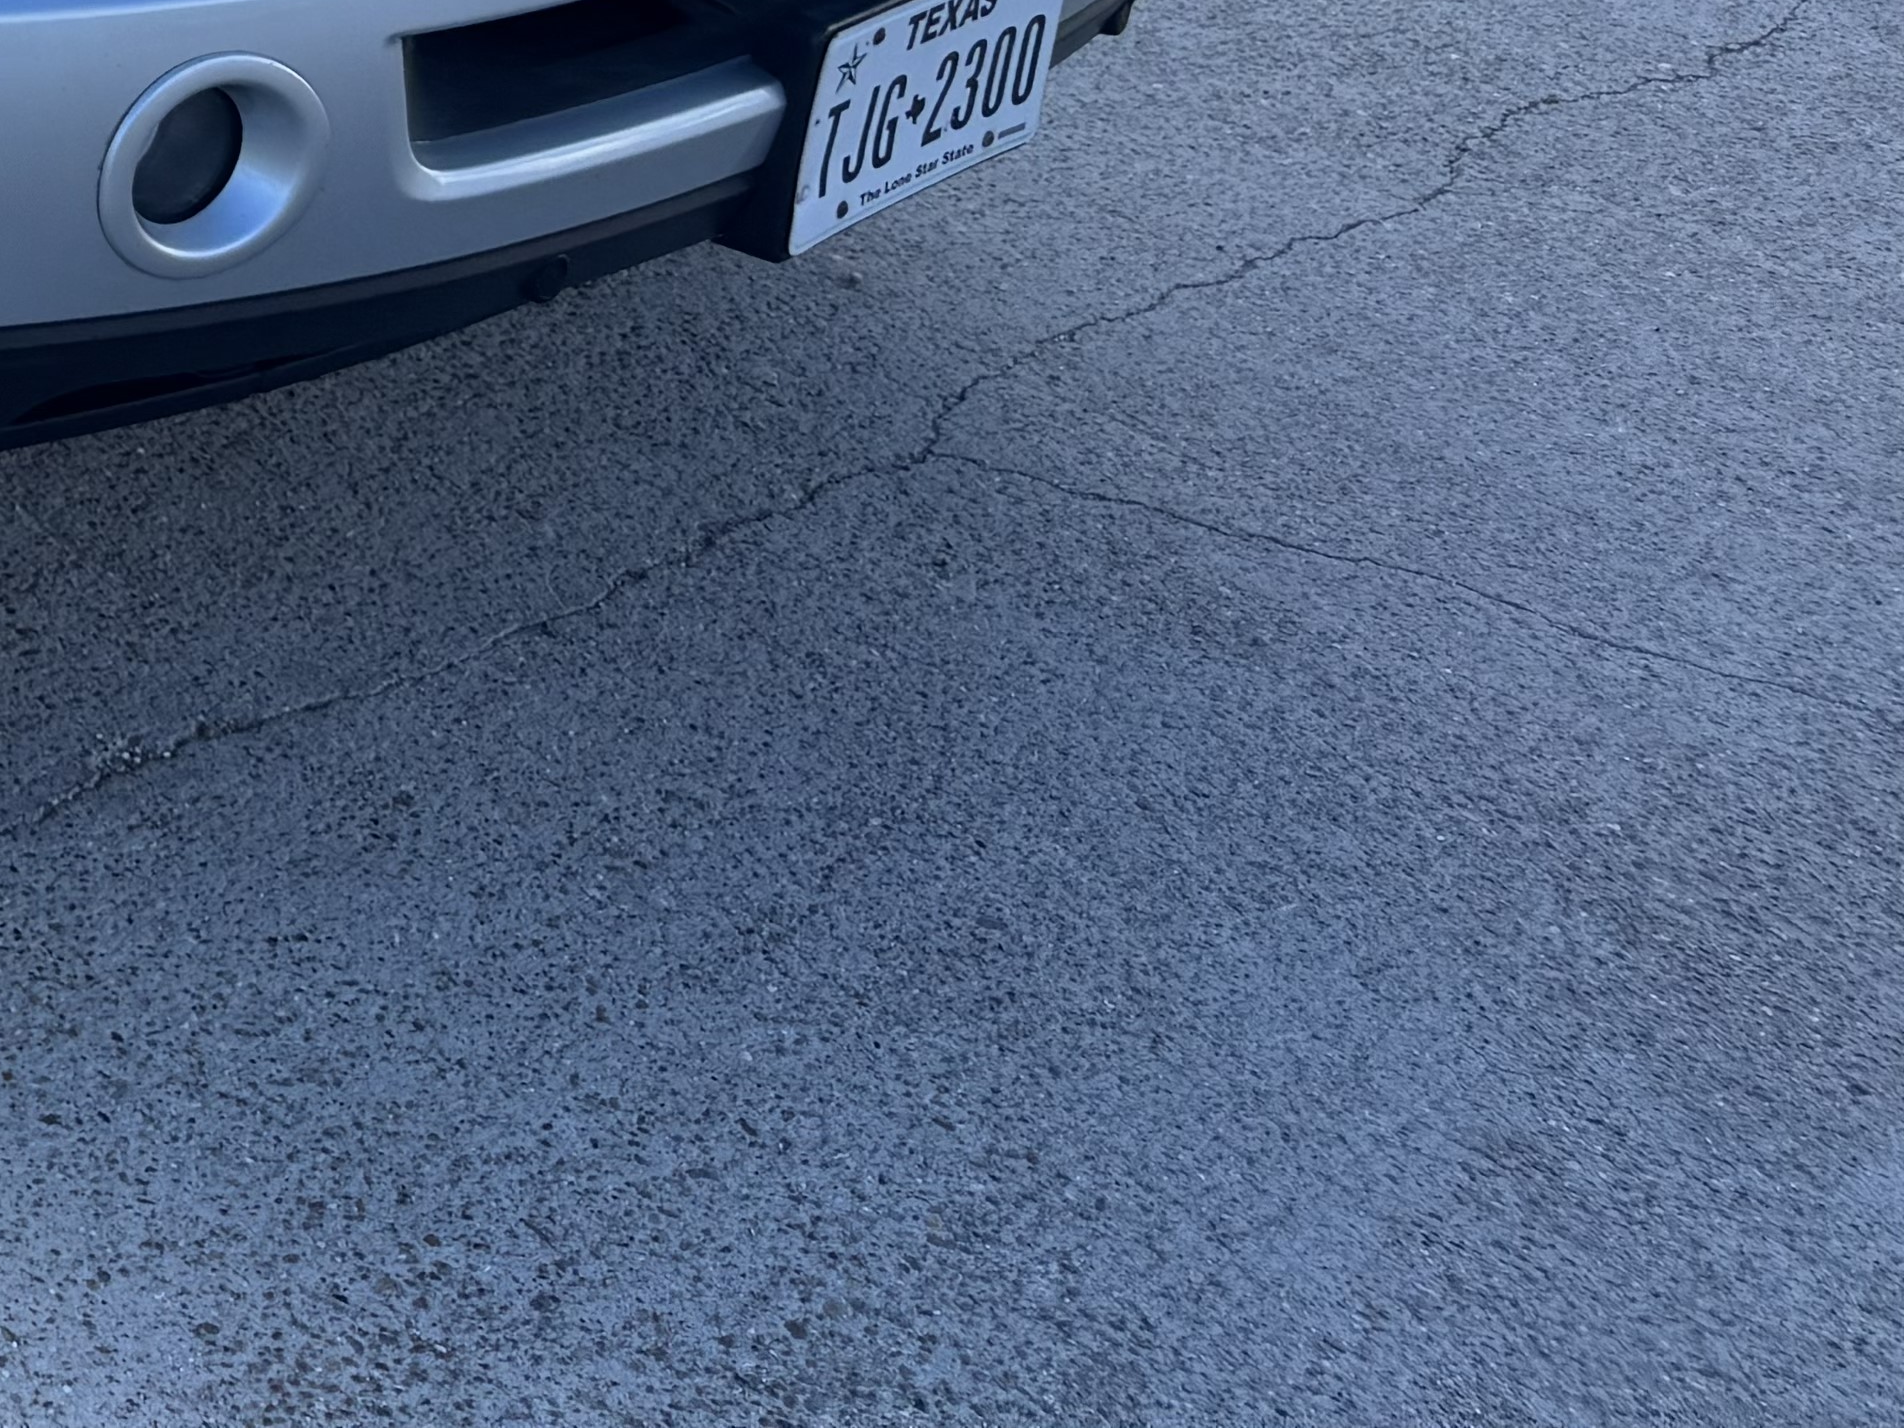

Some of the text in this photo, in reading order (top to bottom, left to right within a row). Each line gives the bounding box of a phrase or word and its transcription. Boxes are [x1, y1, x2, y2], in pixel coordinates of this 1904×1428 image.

[818, 13, 1047, 199] TJG 2300
[859, 144, 974, 206] The Lone Star State
